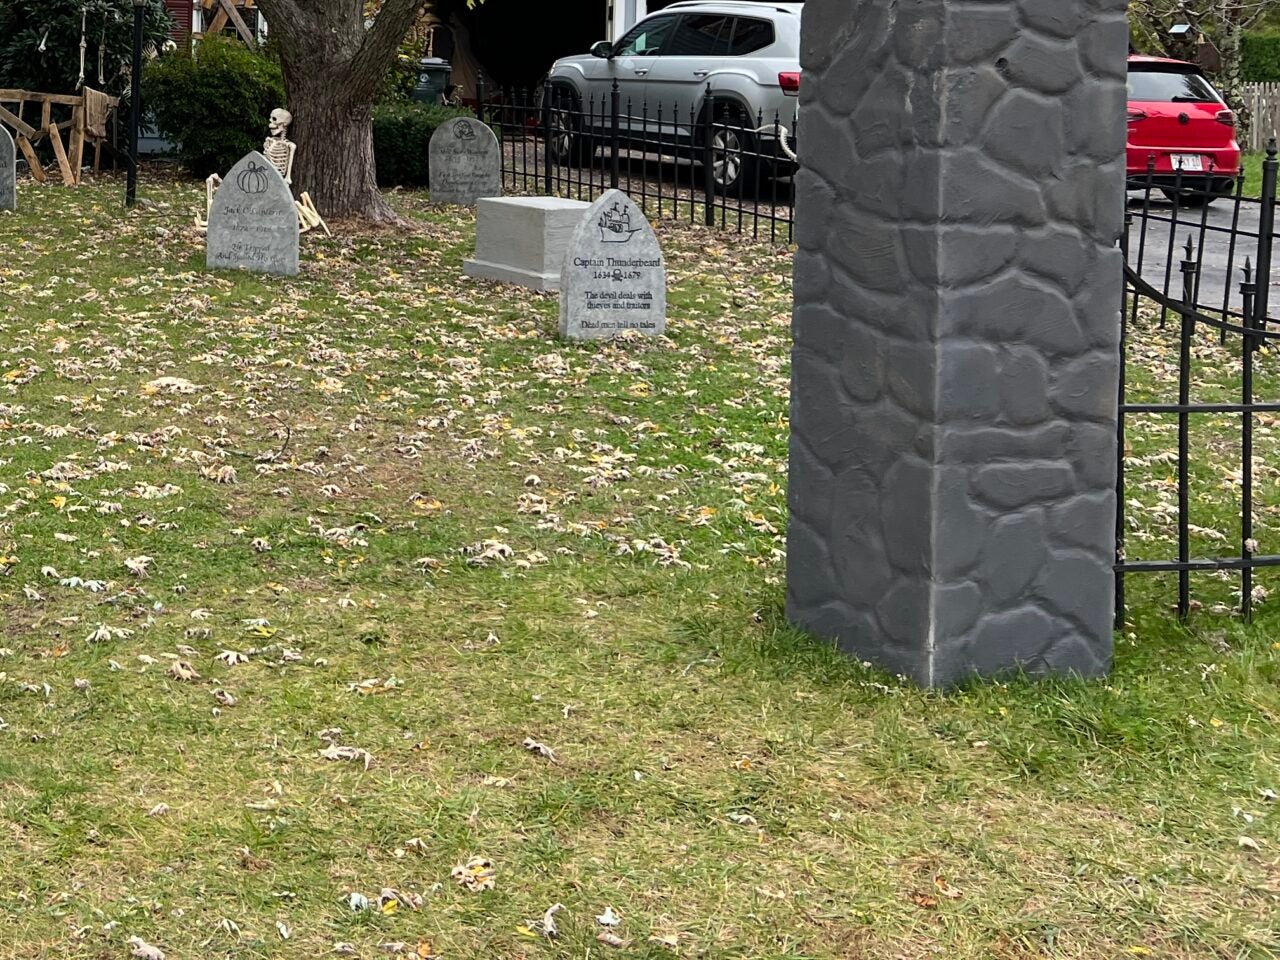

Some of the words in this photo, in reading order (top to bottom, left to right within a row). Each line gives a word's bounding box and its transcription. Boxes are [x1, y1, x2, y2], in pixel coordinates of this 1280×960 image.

[574, 257, 604, 268] Captain
[606, 257, 660, 268] Thunderbeard
[593, 271, 610, 279] 1634
[624, 271, 641, 280] 1679
[584, 291, 600, 300] The
[600, 290, 617, 300] devil
[618, 290, 636, 300] deals
[638, 291, 653, 300] with
[586, 301, 611, 310] thieves
[612, 301, 625, 310] and
[626, 302, 651, 310] traitors
[581, 320, 600, 328] Dead
[618, 320, 628, 328] tell
[640, 320, 656, 328] tales
